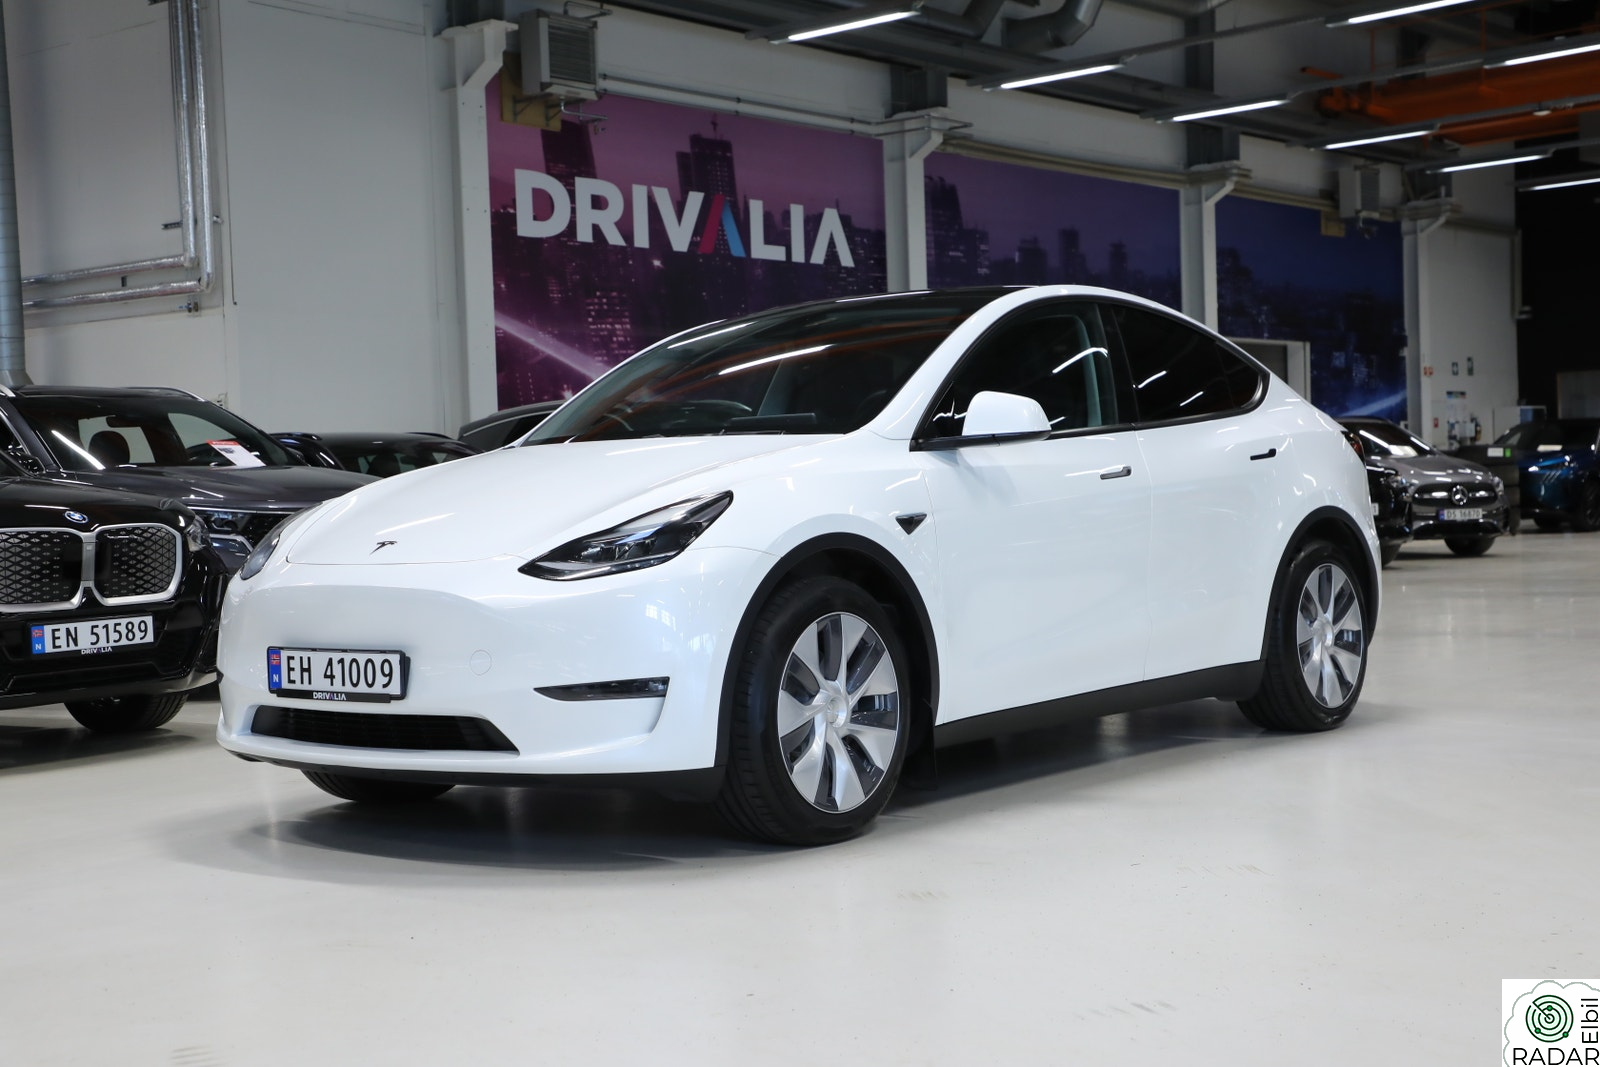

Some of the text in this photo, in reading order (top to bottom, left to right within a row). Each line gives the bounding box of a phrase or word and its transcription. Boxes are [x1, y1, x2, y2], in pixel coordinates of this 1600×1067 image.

[514, 168, 855, 268] DRIVALIA
[51, 619, 149, 650] EN 51589
[272, 673, 279, 682] N
[286, 655, 393, 689] EH 41009
[312, 691, 347, 701] DRIVALIA
